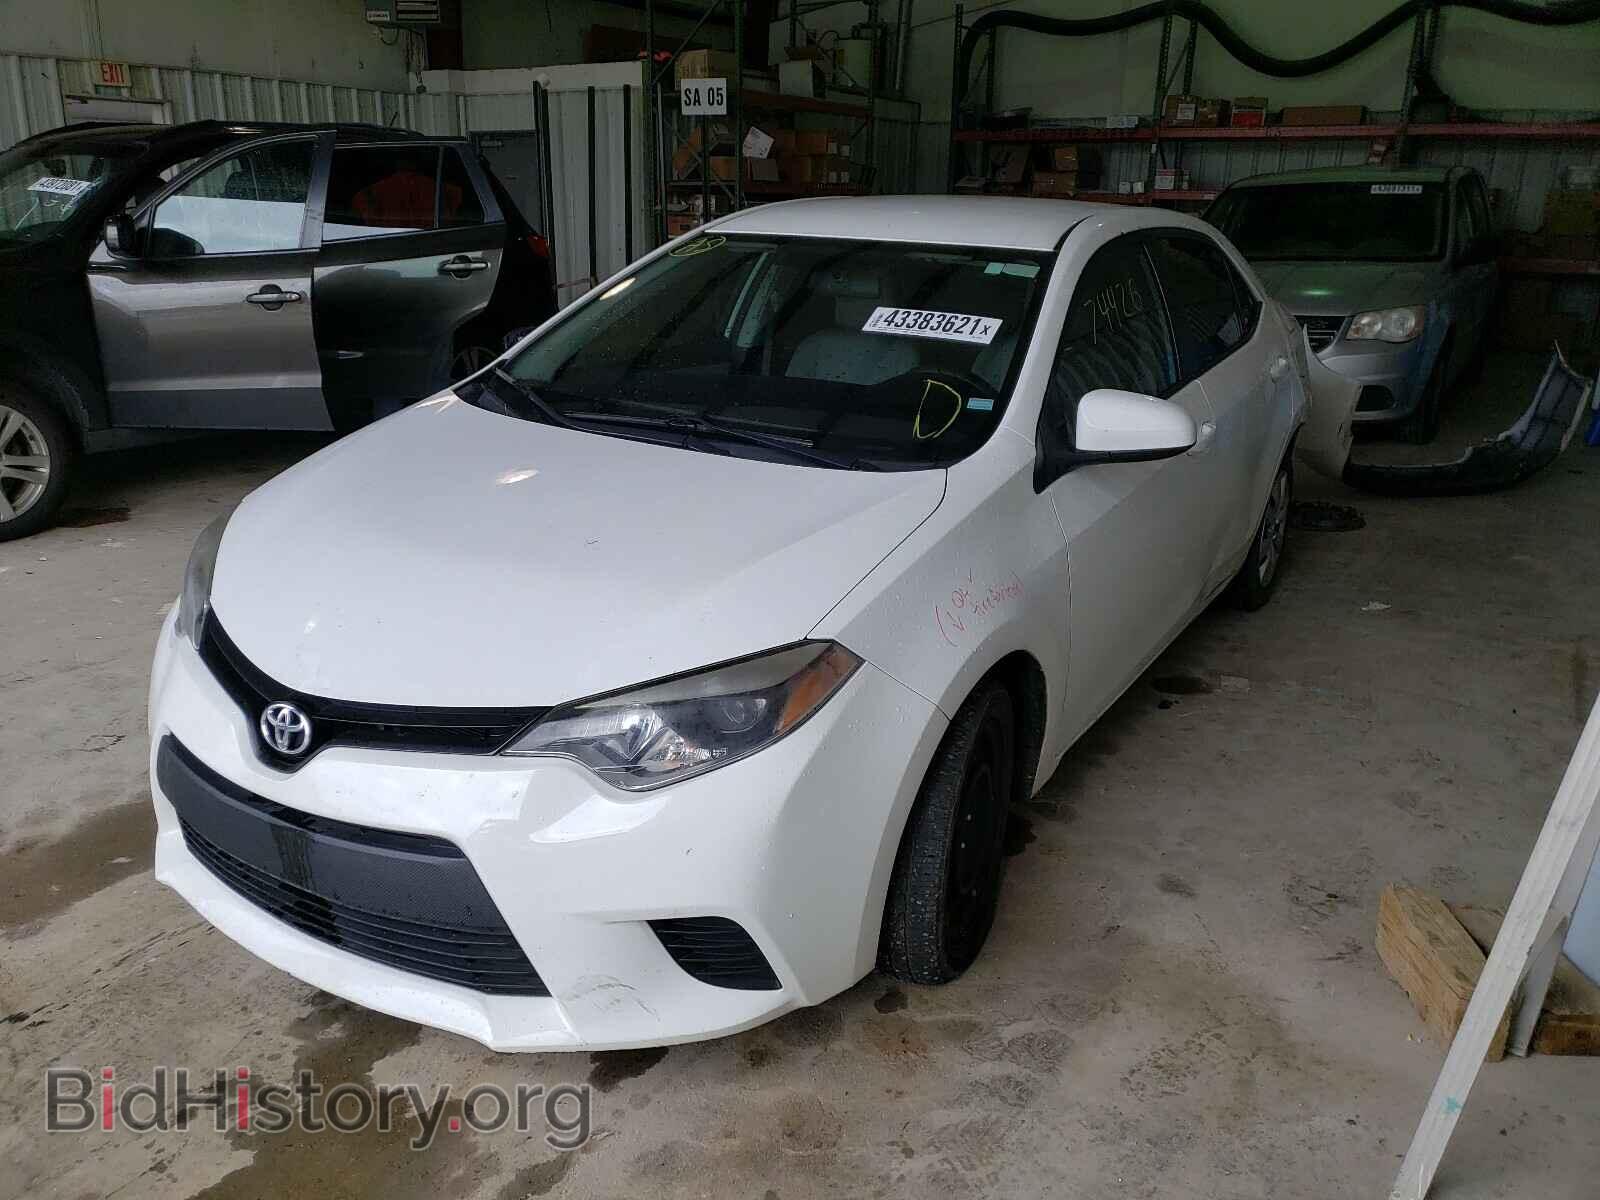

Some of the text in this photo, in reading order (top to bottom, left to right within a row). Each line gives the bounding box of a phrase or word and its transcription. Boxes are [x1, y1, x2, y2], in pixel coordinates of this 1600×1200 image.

[101, 63, 125, 83] EXIT
[684, 87, 724, 106] SA 05
[883, 310, 982, 336] 43383621
